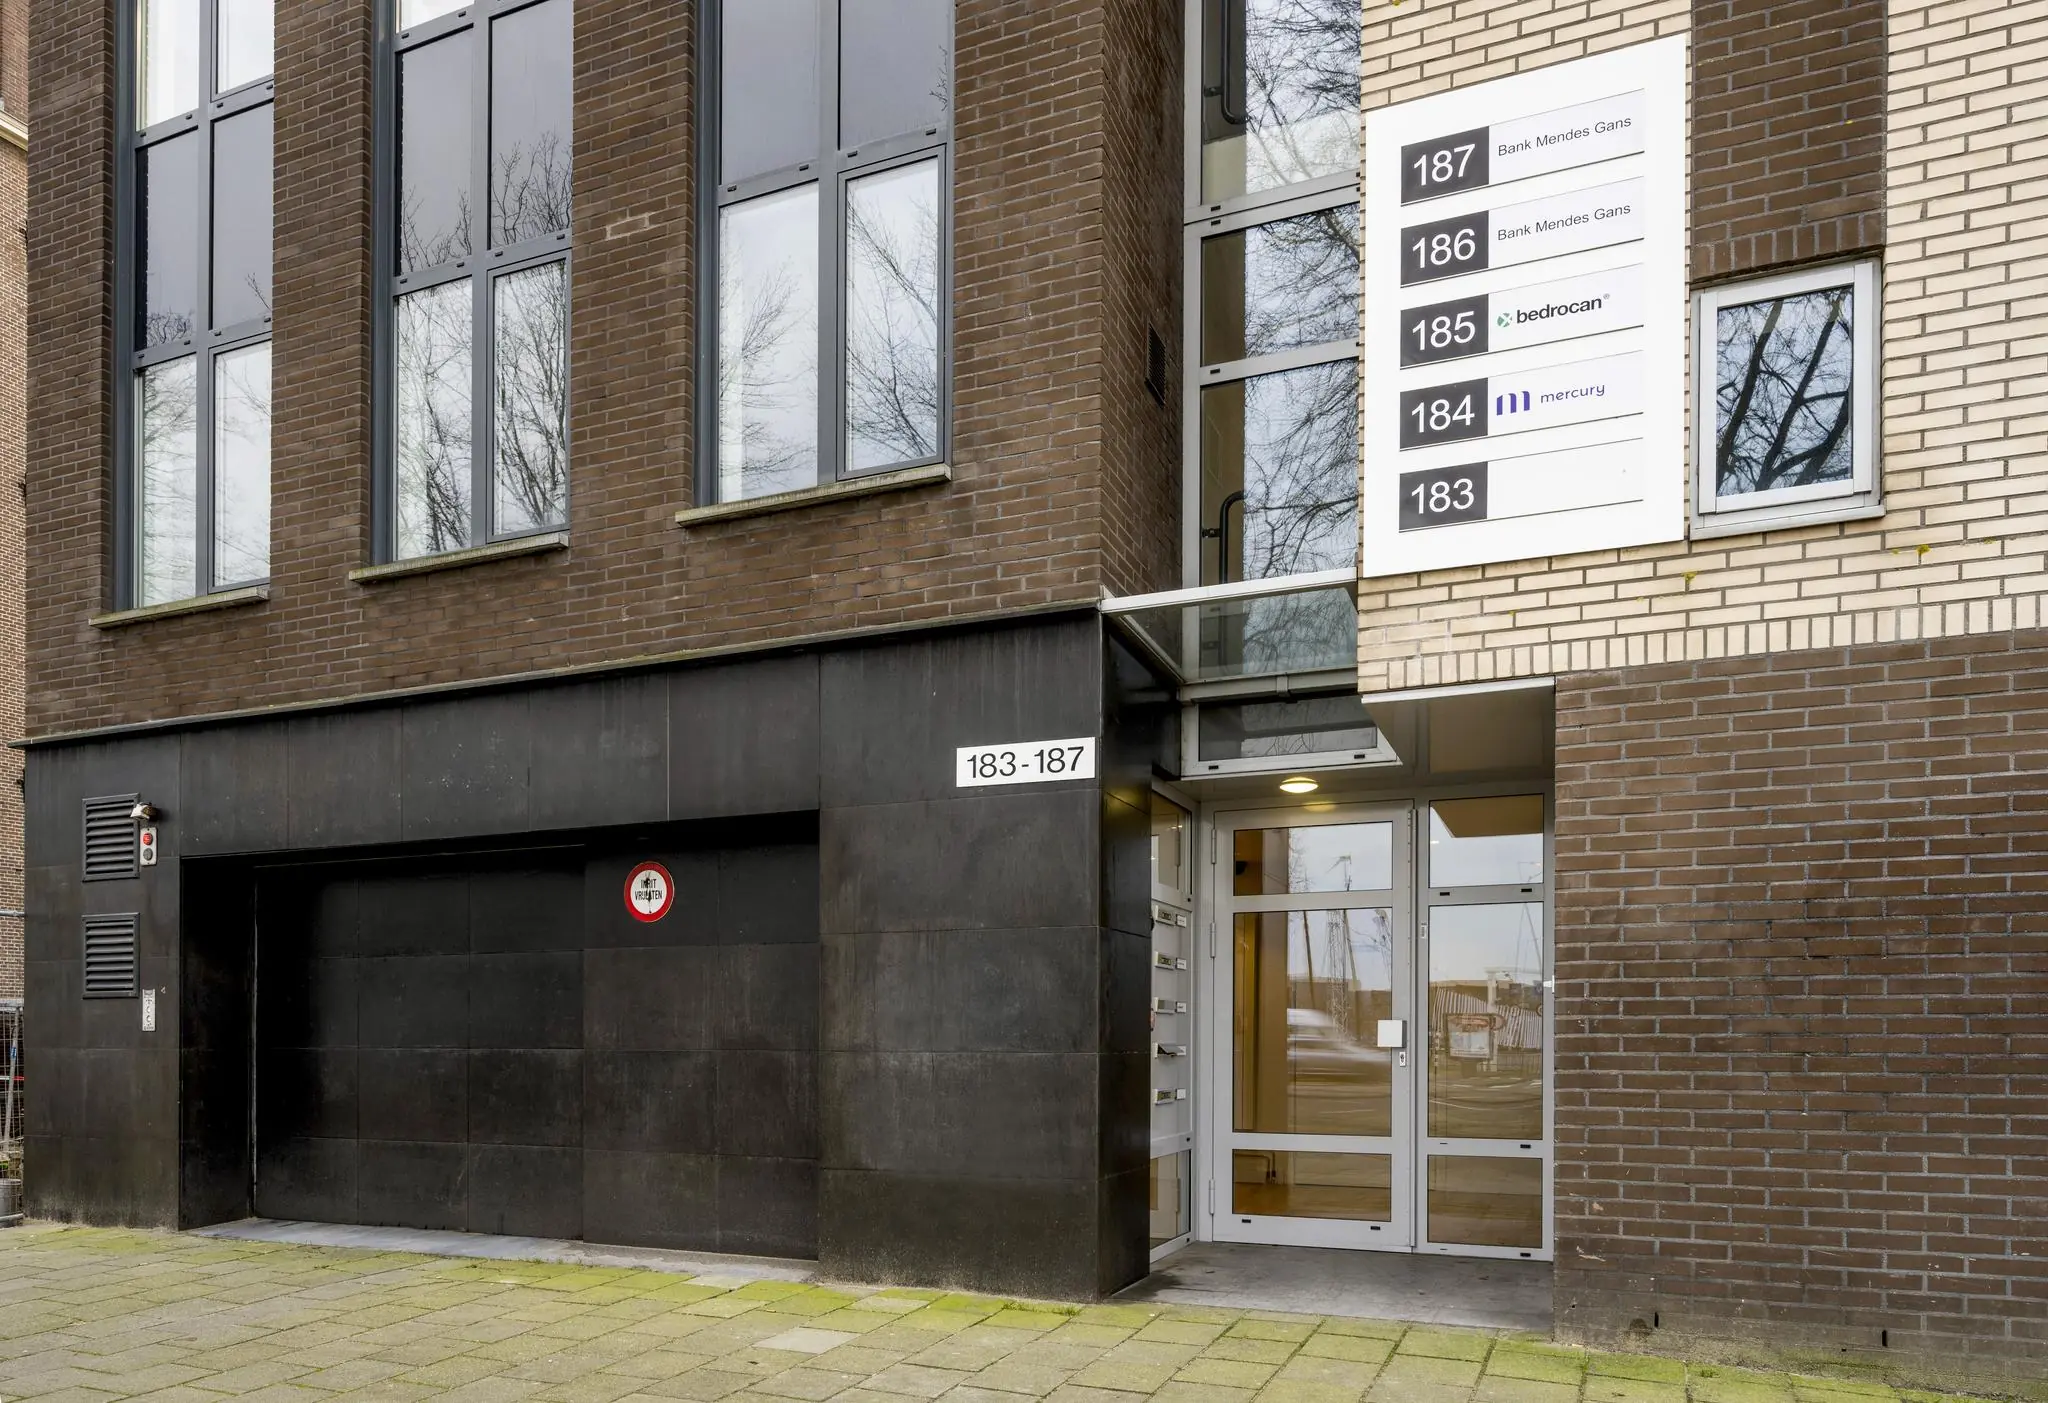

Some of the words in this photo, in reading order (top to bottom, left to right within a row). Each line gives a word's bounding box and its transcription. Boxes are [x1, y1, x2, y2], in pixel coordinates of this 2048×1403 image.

[1413, 143, 1476, 186] 187
[1498, 139, 1532, 157] Bank
[1536, 128, 1590, 148] Mendes
[1594, 116, 1632, 134] Gans
[1412, 228, 1476, 268] 186
[1497, 224, 1531, 241] Bank
[1535, 214, 1590, 233] Mendes
[1593, 204, 1631, 221] Gans
[1411, 310, 1476, 351] 185
[1411, 394, 1475, 433] 184
[1540, 383, 1605, 404] mercury
[1411, 478, 1475, 514] 183
